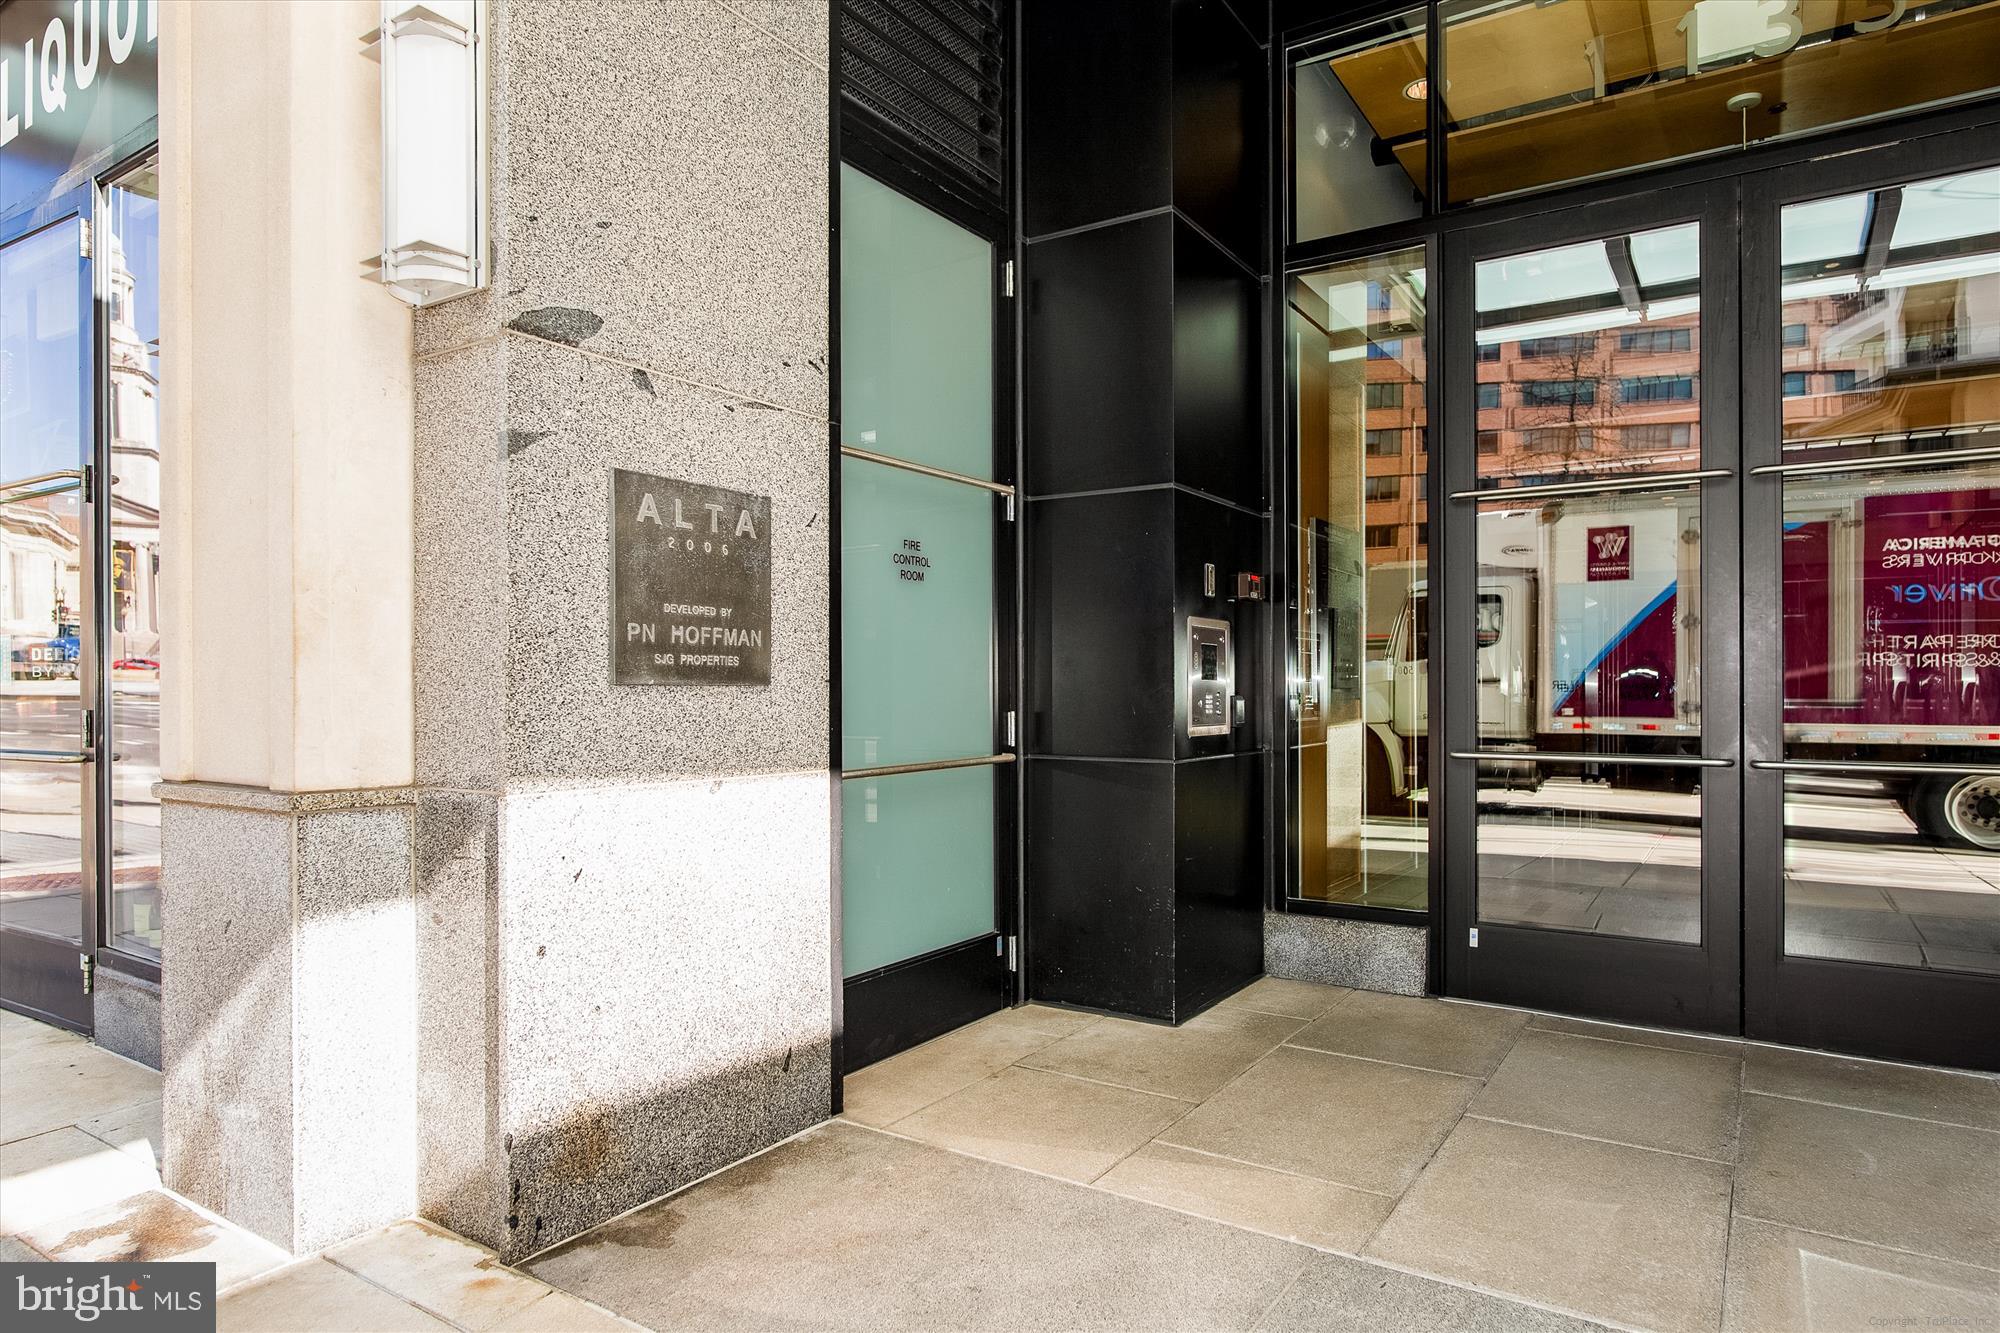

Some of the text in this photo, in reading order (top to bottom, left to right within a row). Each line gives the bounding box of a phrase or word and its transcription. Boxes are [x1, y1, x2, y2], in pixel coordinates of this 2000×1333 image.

[0, 0, 157, 147] LIQUO
[636, 492, 757, 539] ALTA
[903, 539, 921, 552] FIRE
[893, 553, 931, 568] CONTROL
[900, 569, 925, 582] ROOM
[663, 603, 733, 617] DEVELOPED BY
[627, 622, 762, 647] PN HOFFMAN
[654, 653, 740, 667] SJG PROPERTIES
